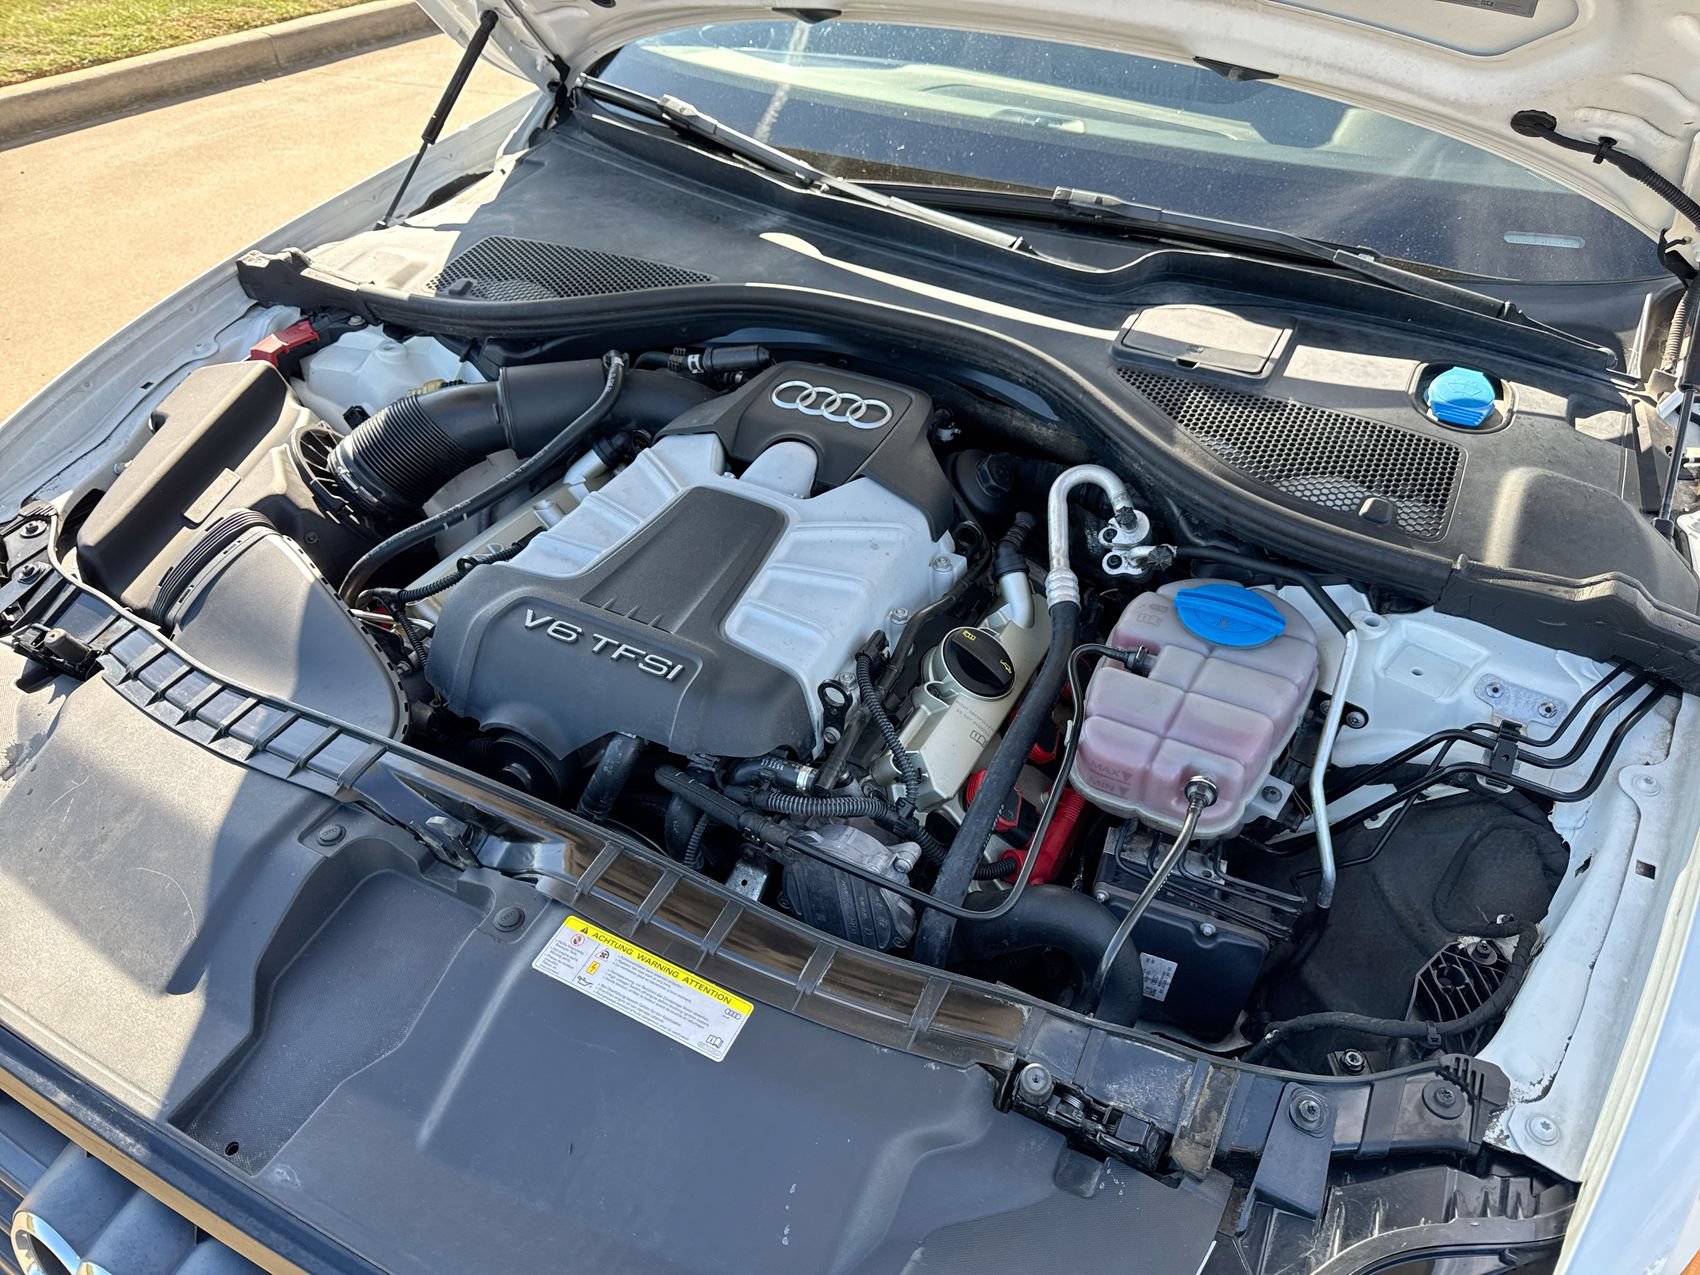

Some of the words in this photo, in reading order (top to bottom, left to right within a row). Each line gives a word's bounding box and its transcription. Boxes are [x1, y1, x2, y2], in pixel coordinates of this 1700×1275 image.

[524, 608, 583, 643] V6
[591, 633, 685, 681] TFSI
[1088, 759, 1121, 777] MAX
[1088, 775, 1115, 792] MIN
[592, 932, 634, 956] ACHTUNG
[637, 953, 680, 979] WARNING
[682, 976, 732, 1005] ATTENTION
